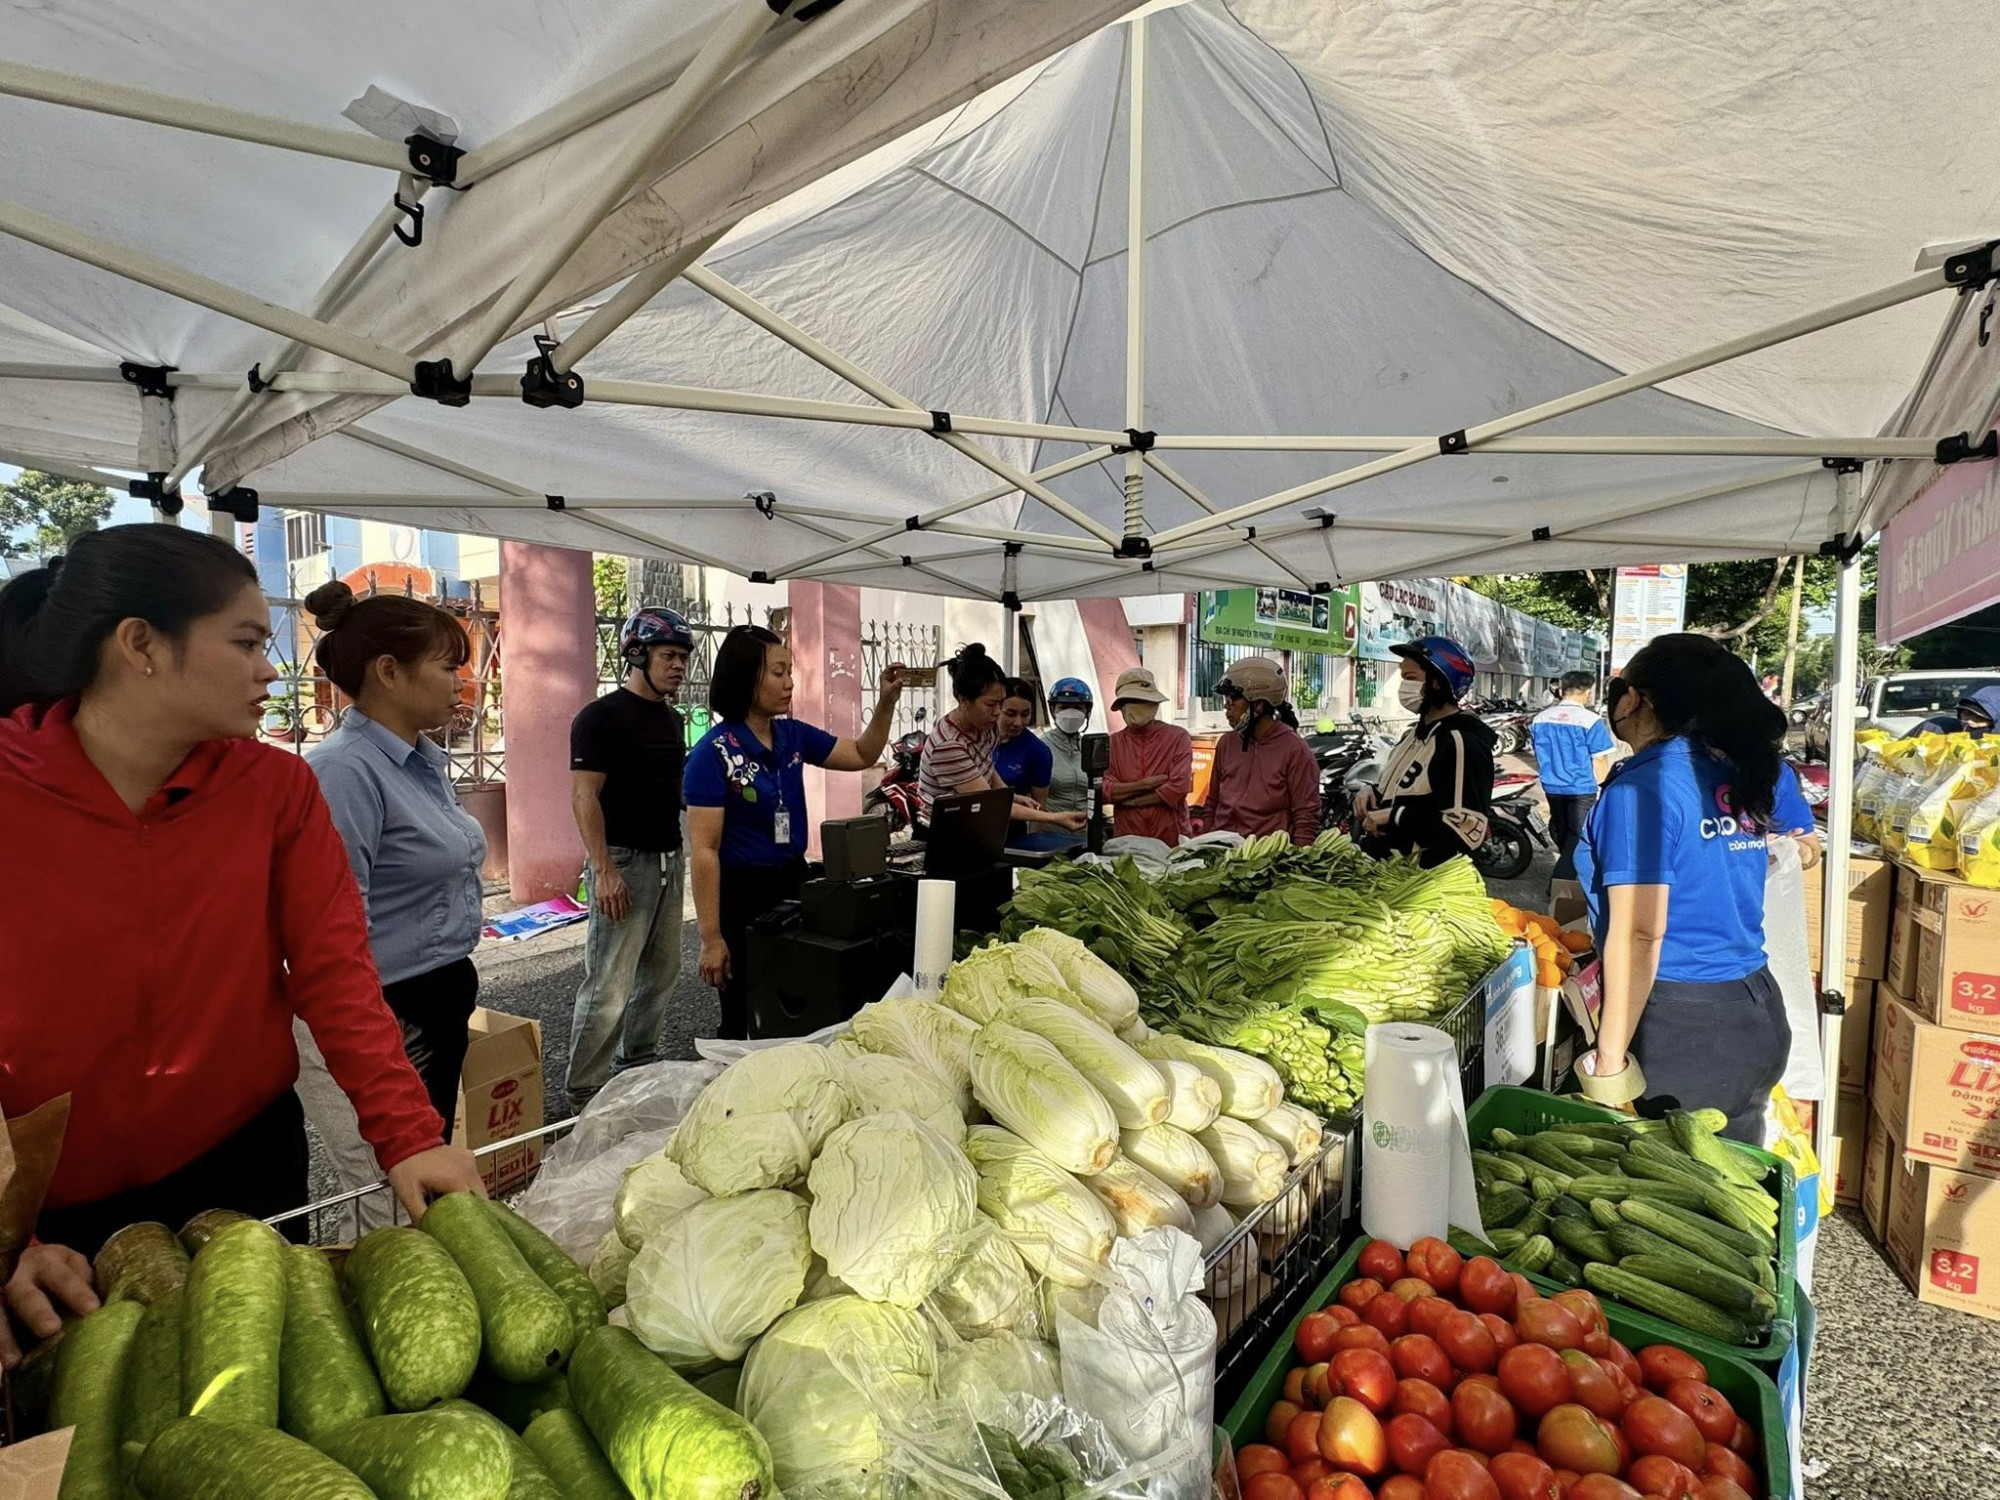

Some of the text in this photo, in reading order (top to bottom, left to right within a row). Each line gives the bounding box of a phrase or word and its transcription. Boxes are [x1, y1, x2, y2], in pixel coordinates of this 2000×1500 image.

[1958, 980, 1997, 1000] 3,2
[1968, 1002, 1985, 1014] kg
[1936, 1257, 1974, 1279] 3,2
[1945, 1280, 1962, 1292] kg
